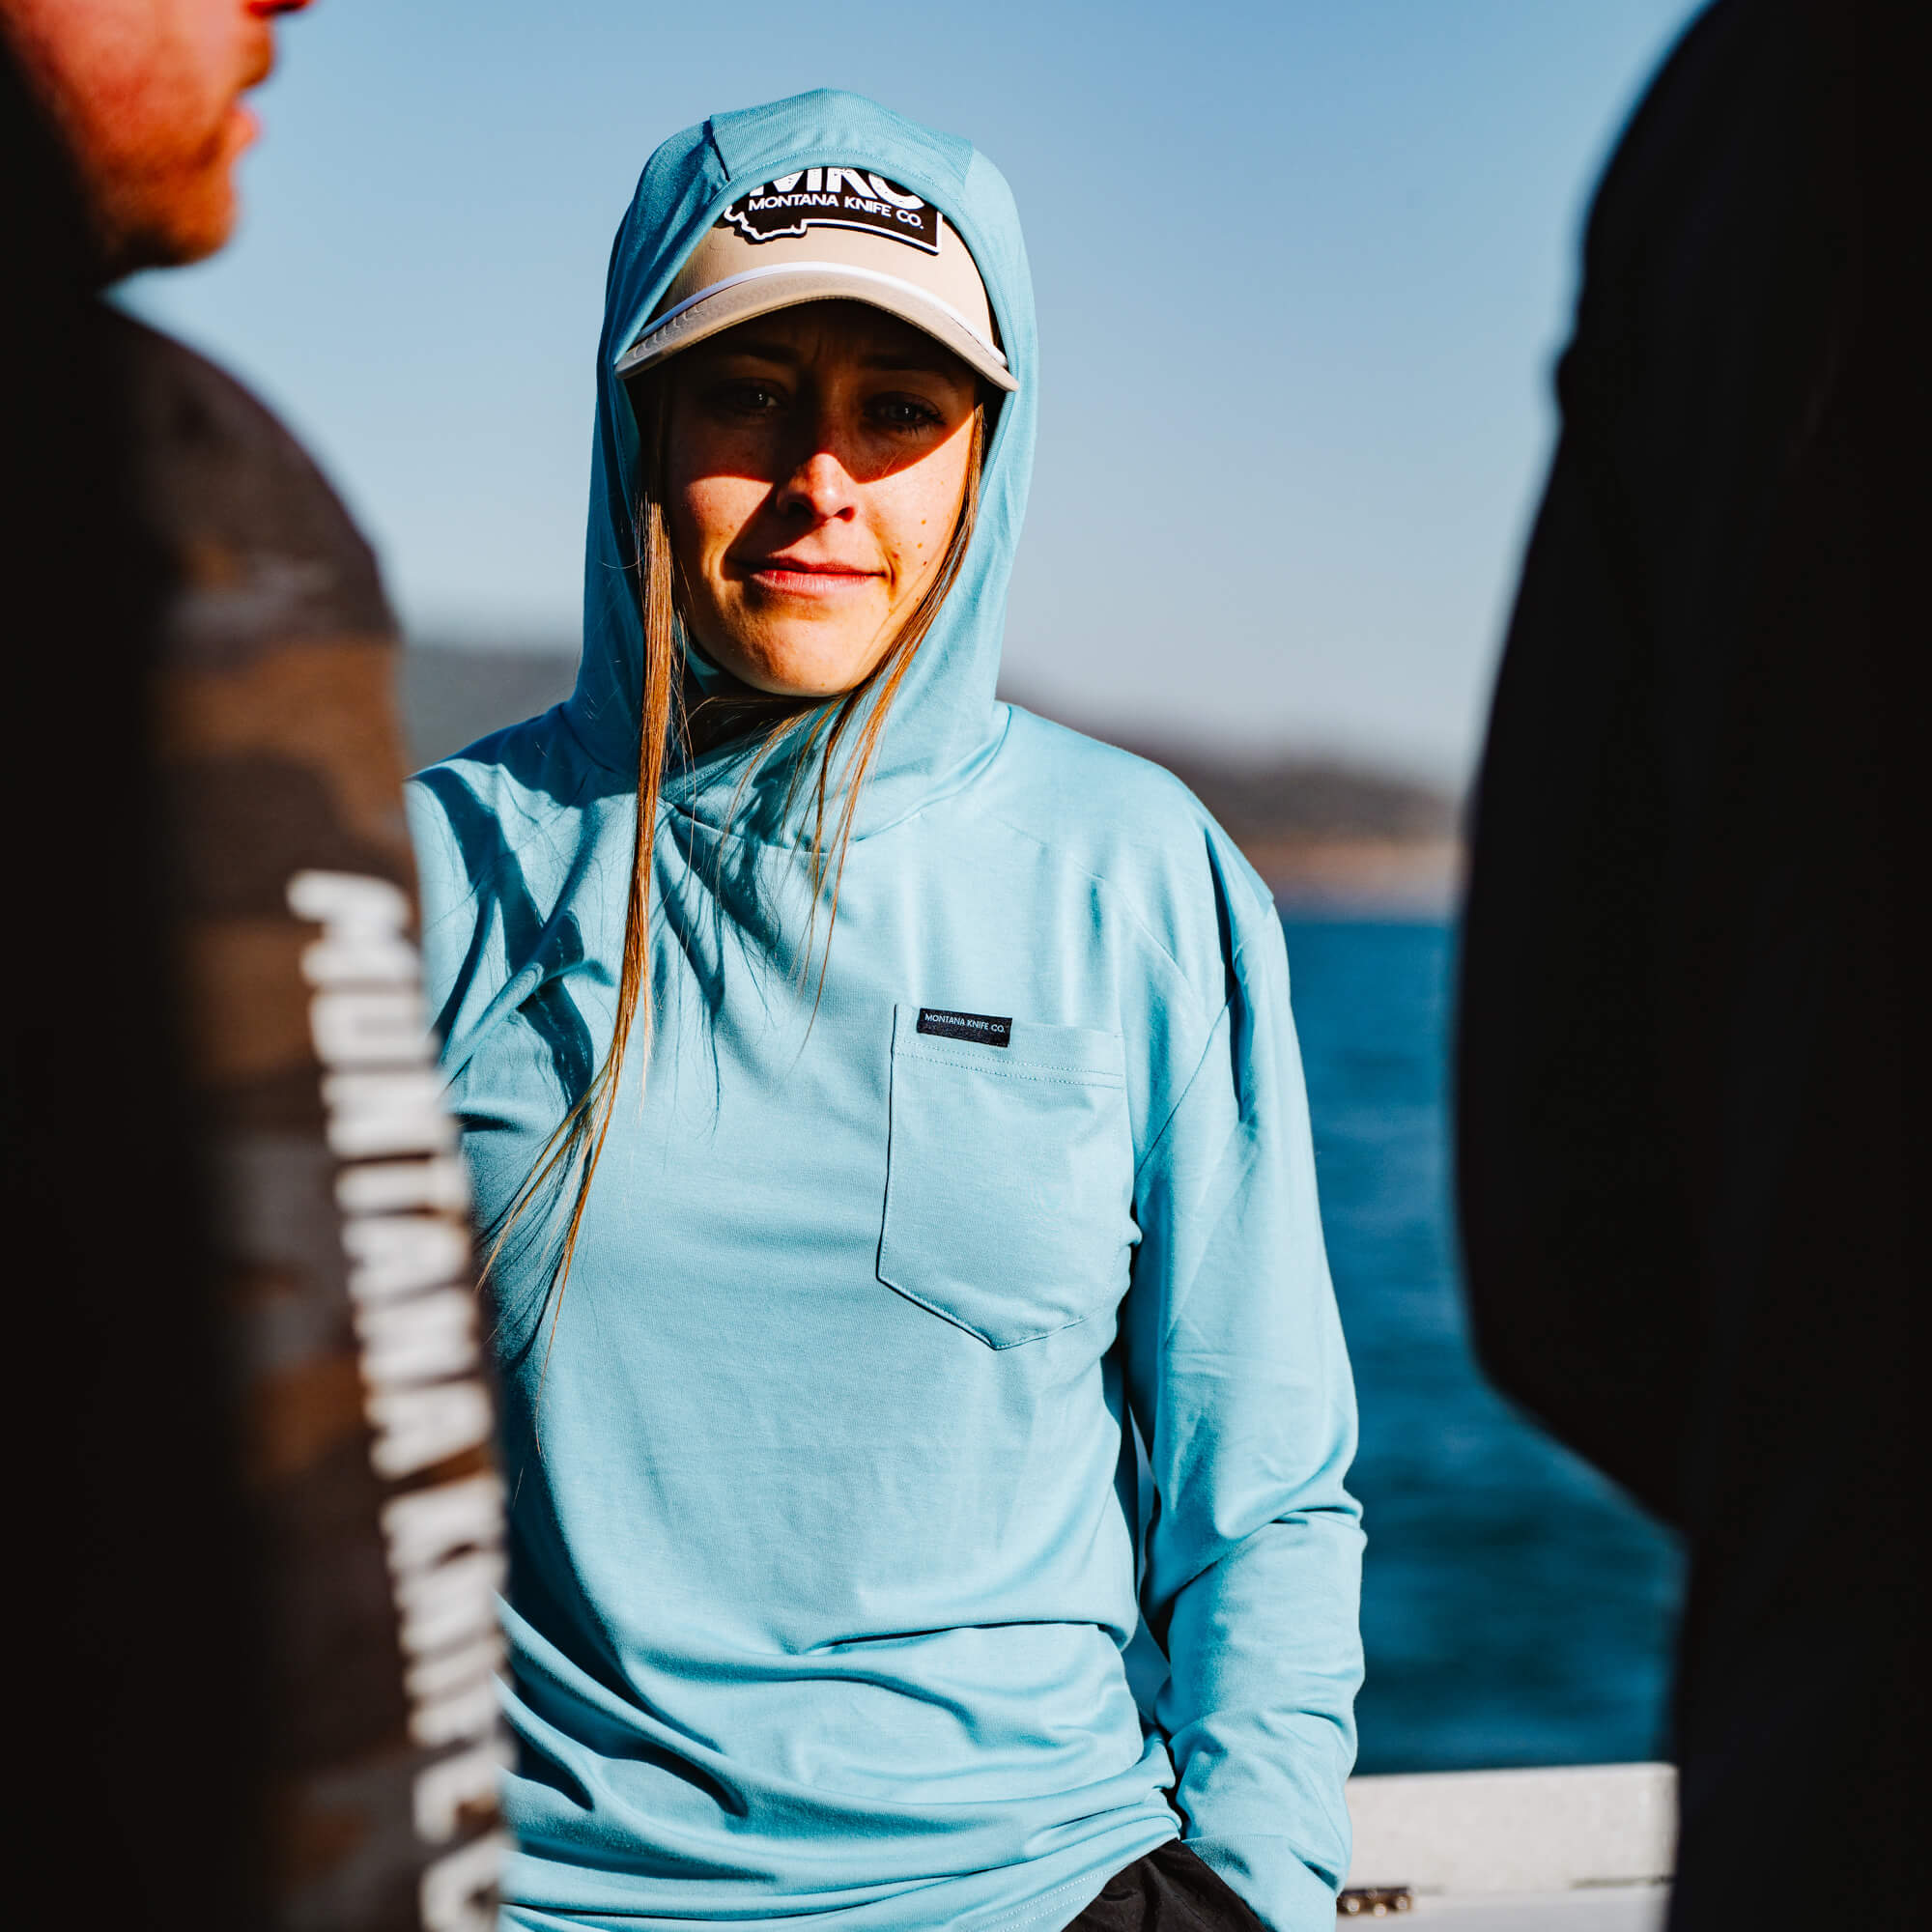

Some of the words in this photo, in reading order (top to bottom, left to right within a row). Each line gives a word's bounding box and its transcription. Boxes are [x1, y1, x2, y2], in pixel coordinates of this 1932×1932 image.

[749, 193, 838, 212] MONTANA
[844, 195, 892, 217] KNIFE
[895, 209, 924, 230] CO.
[924, 1013, 965, 1026] MONTANA
[966, 1019, 989, 1031] KNIFE
[990, 1024, 1006, 1034] CO.
